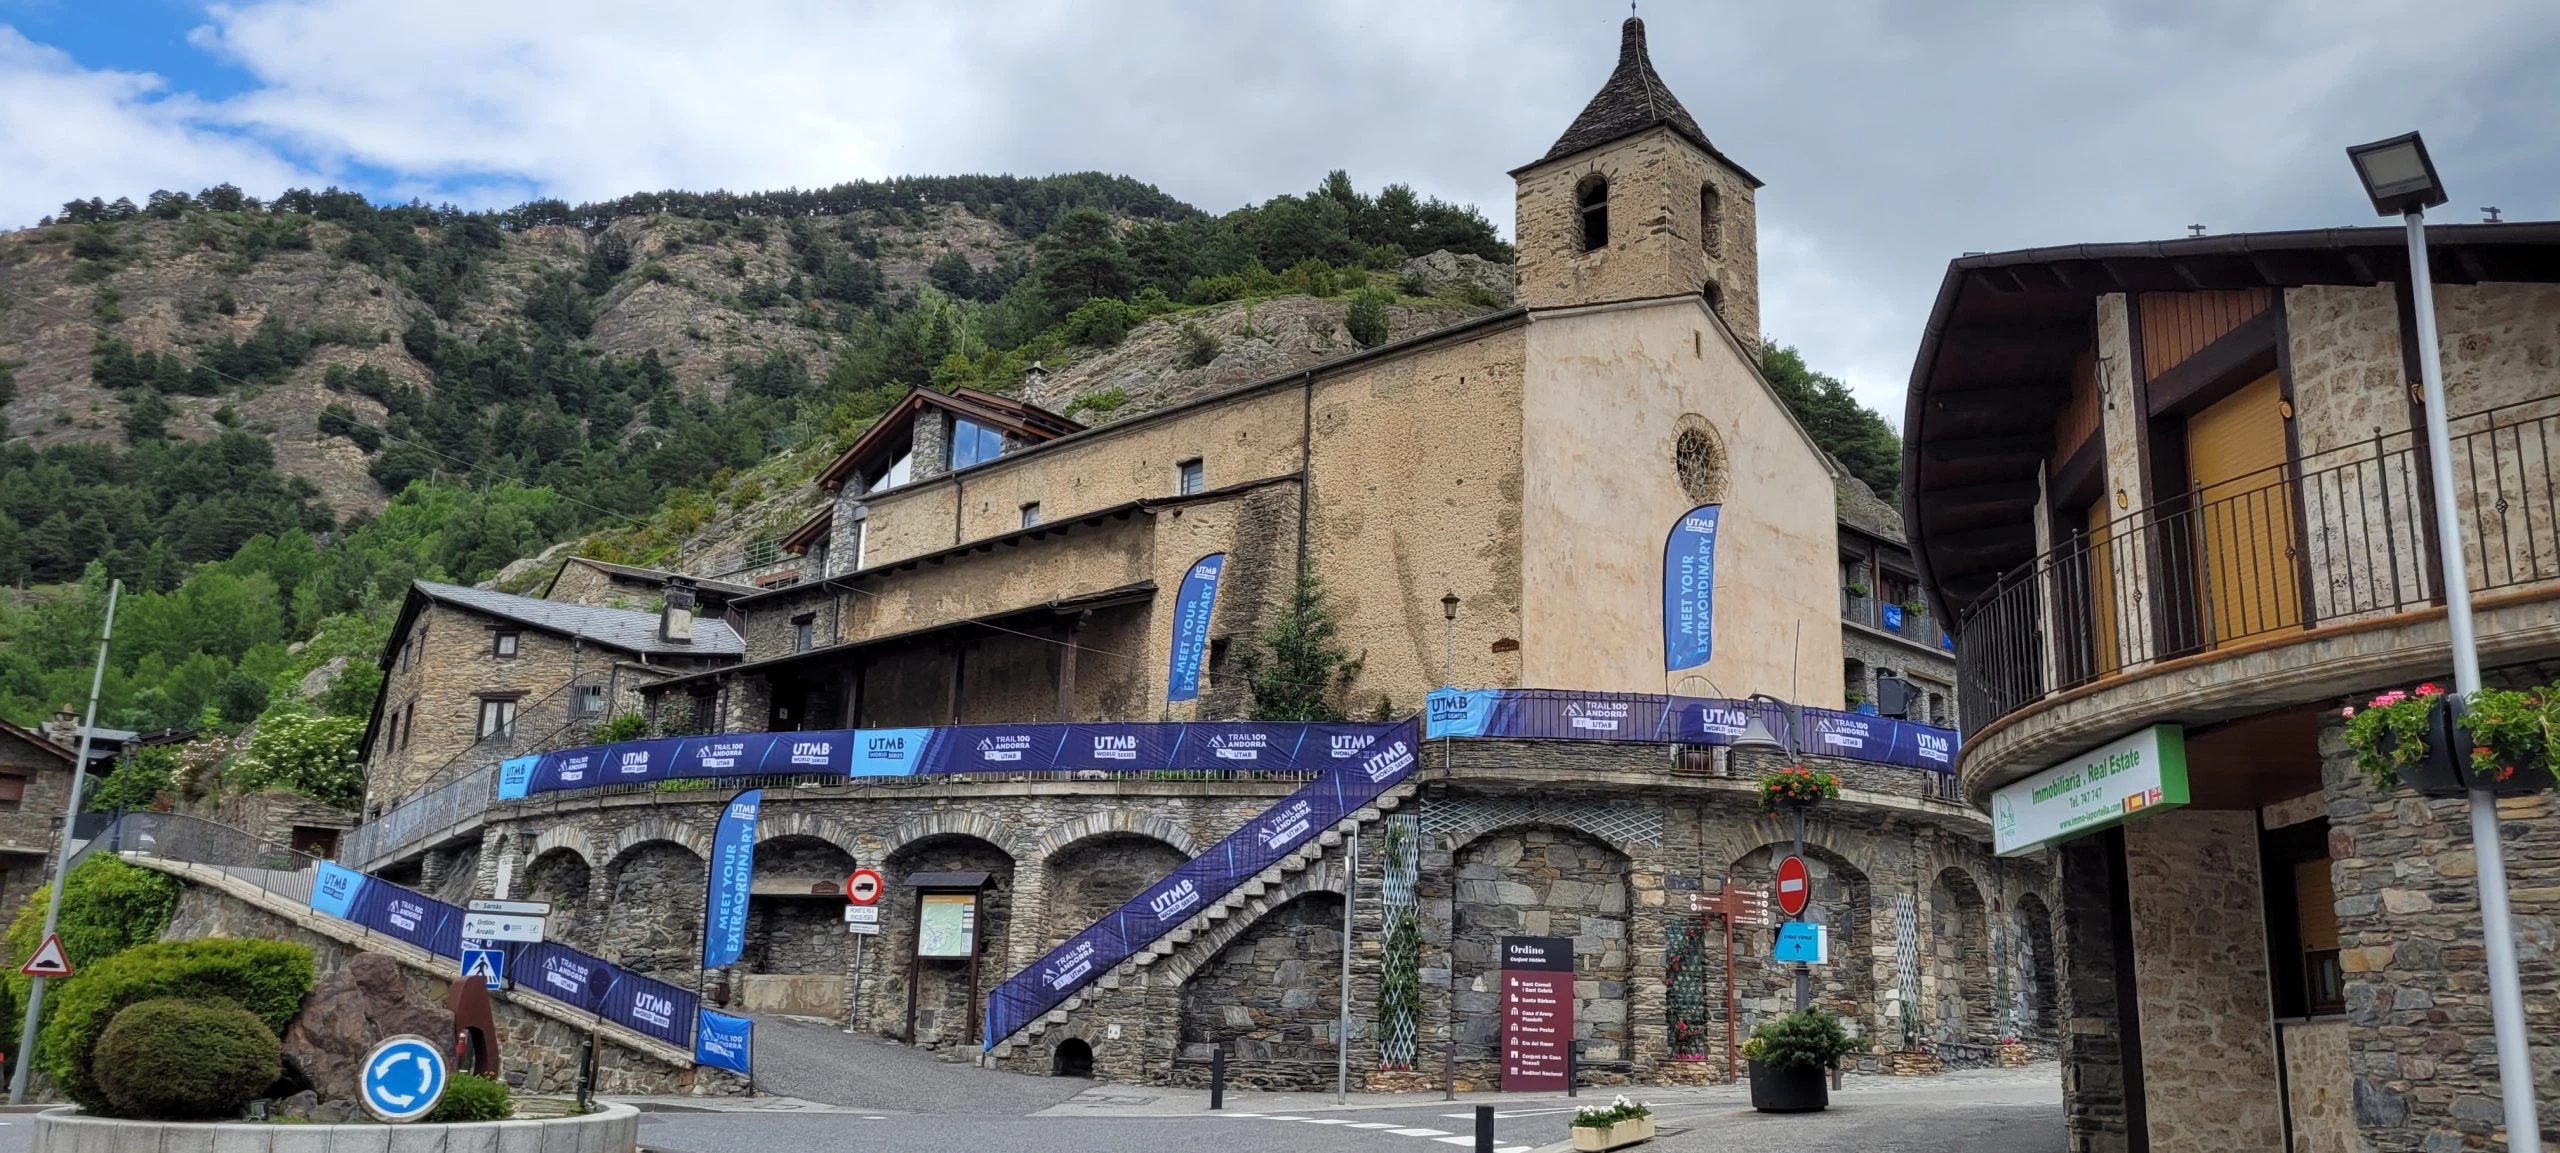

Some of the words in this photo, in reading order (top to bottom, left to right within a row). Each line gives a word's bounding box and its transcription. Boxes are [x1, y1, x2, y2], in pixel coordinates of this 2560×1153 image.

[1686, 518, 1714, 527] UTMB
[1196, 565, 1216, 575] UTMB
[1681, 555, 1694, 595] YOUR
[1697, 537, 1711, 653] EXTRAORDINARY
[1182, 600, 1197, 637] YOUR
[1681, 599, 1693, 634] MEET
[1184, 583, 1213, 691] EXTRAORDINARY
[1176, 641, 1190, 673] MEET
[1432, 696, 1467, 712] UTMB
[1586, 710, 1628, 718] ANDORRA
[1703, 709, 1746, 725] UTMB
[1836, 727, 1869, 738] ANDORRA
[793, 742, 830, 755] UTMB
[868, 737, 905, 750] UTMB
[995, 742, 1031, 750] ANDORRA
[1094, 736, 1136, 749] UTMB
[1917, 733, 1948, 751] UTMB
[622, 751, 649, 765] UTMB
[1363, 741, 1407, 774] UTMB
[506, 764, 526, 778] UTMB
[1374, 766, 1394, 780] WORLD
[1394, 755, 1412, 769] SERIES
[2032, 770, 2081, 805] Immobiliaria
[2088, 758, 2107, 783] Real
[2109, 748, 2140, 775] Estate
[2069, 795, 2080, 808] Tel.
[2080, 790, 2091, 805] 747
[2092, 787, 2102, 802] 747
[732, 804, 755, 814] UTMB
[1275, 807, 1312, 834] ANDORRA
[1287, 824, 1304, 838] UTMB
[723, 844, 737, 887] YOUR
[324, 872, 348, 890] UTMB
[727, 824, 753, 952] EXTRAORDINARY
[1150, 879, 1194, 913] UTMB
[719, 892, 732, 929] MEET
[1160, 904, 1180, 919] WORLD
[1181, 893, 1198, 908] SERIES
[1510, 944, 1544, 955] Ordino
[1059, 948, 1095, 974] ANDORRA
[559, 967, 587, 983] ANDORRA
[1069, 965, 1087, 980] UTMB
[635, 991, 672, 1016] UTMB
[635, 1010, 653, 1018] WORLD
